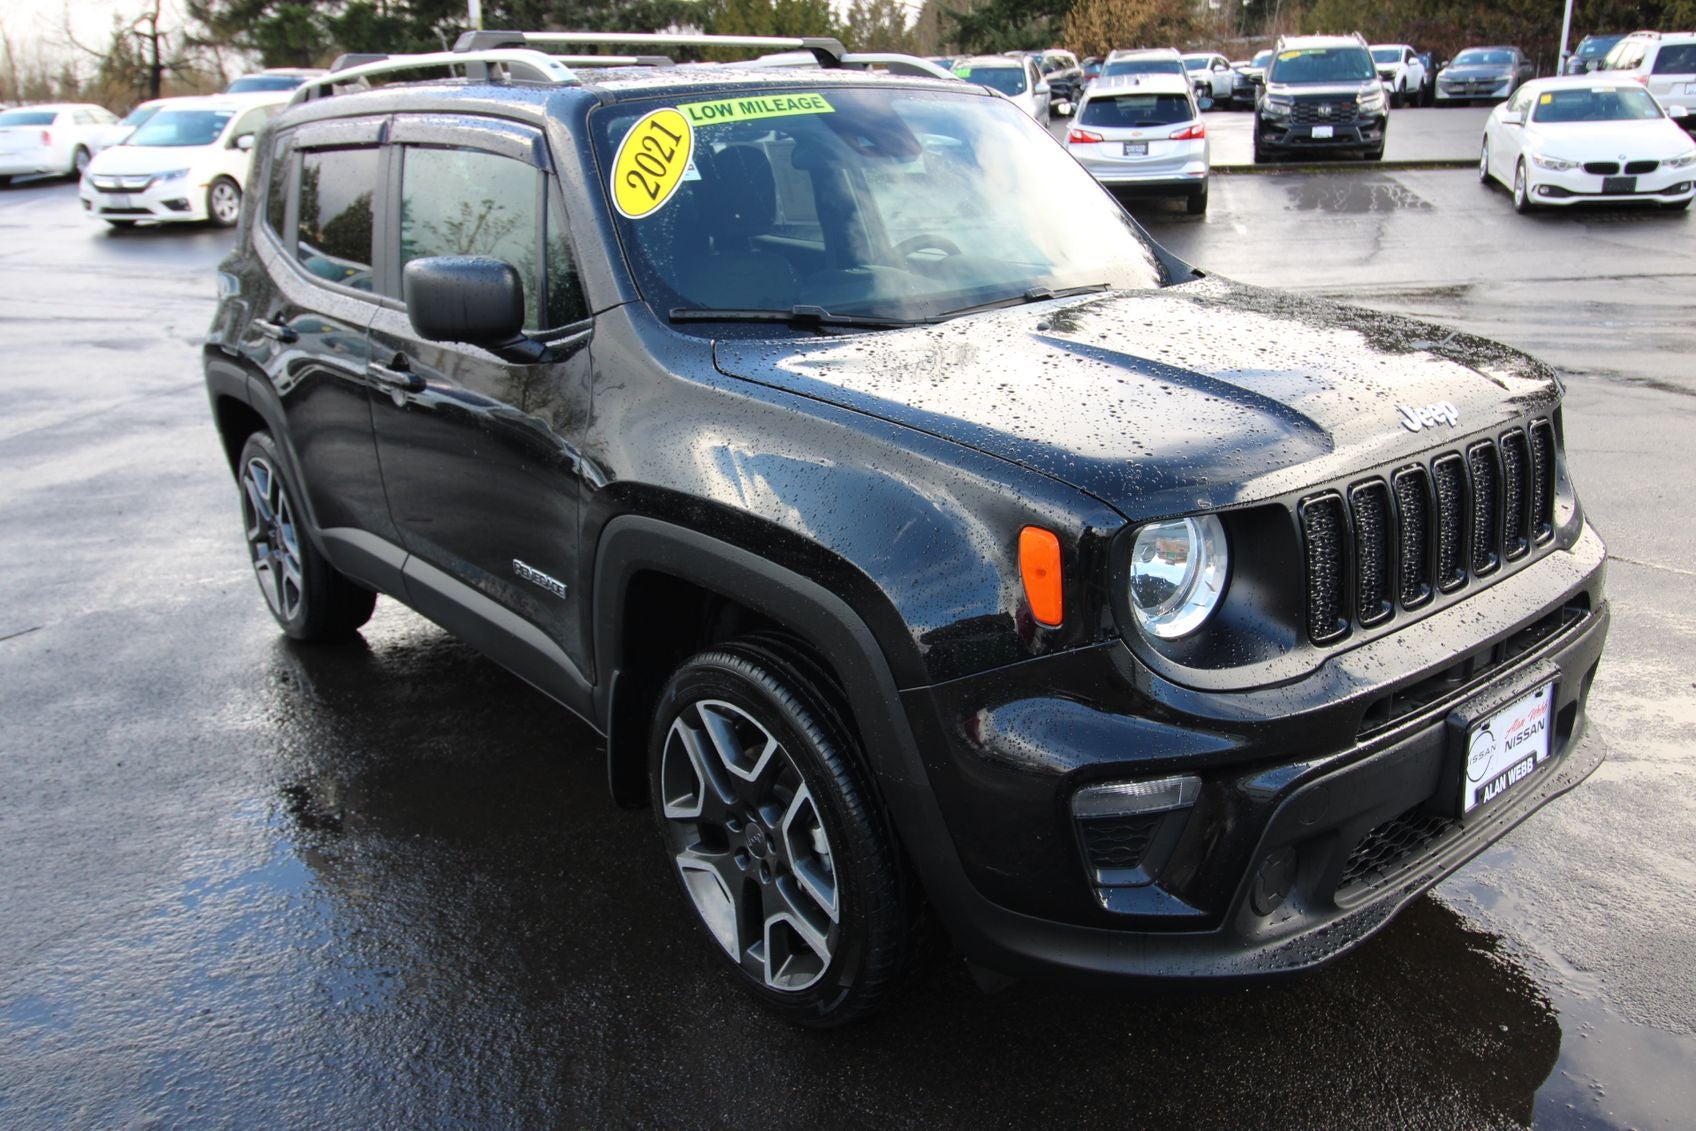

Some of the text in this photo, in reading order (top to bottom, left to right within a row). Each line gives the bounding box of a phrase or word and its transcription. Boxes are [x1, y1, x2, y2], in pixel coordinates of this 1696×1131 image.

[688, 96, 825, 121] LOW MILEAGE
[626, 120, 682, 200] 2021
[1399, 400, 1459, 433] Jeep
[1504, 718, 1545, 753] NISSAN
[1483, 757, 1534, 804] ALAN WEBB
